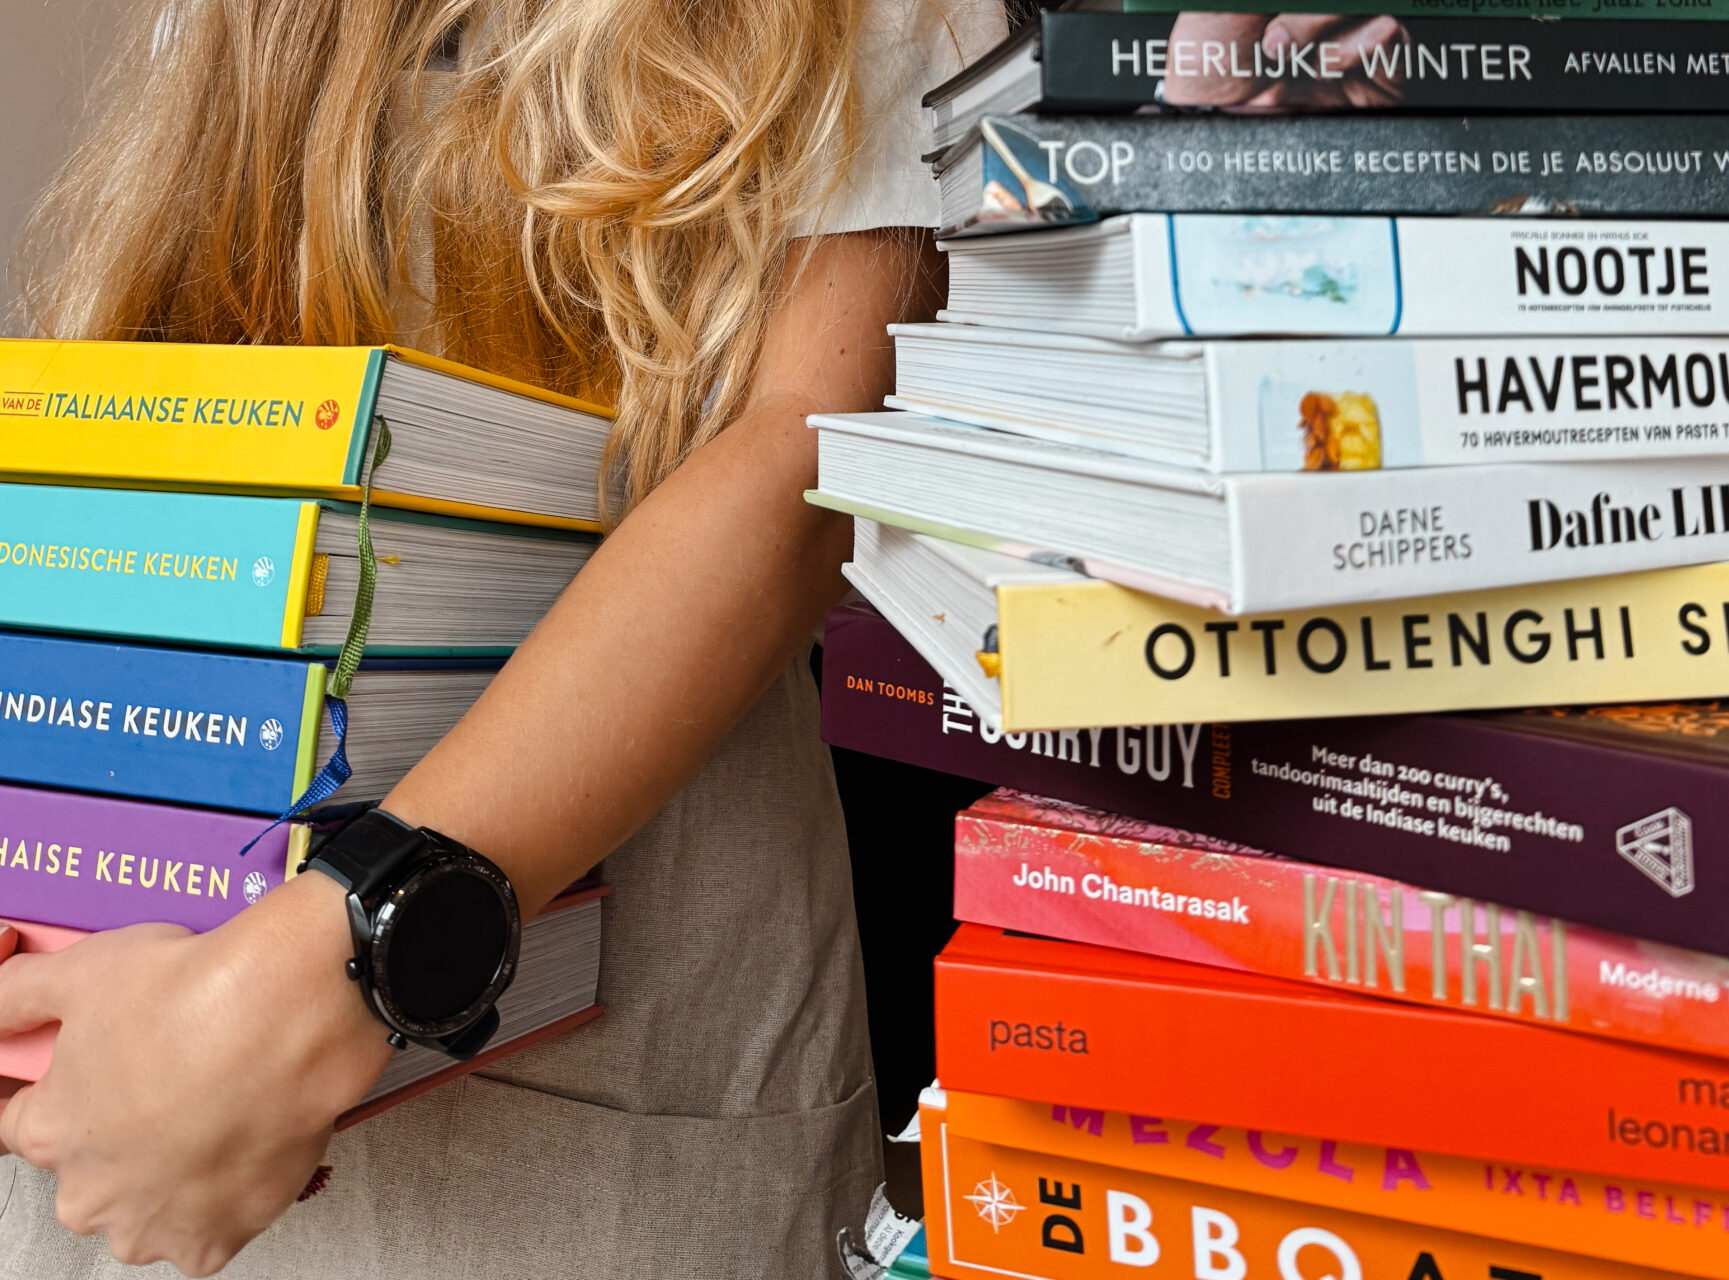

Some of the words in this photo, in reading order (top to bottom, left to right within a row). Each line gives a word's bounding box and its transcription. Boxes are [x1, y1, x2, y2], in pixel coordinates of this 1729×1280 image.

[1111, 38, 1344, 79] HEERLIJKE
[1358, 42, 1532, 81] WINTER
[1564, 51, 1676, 74] AFVALLEN
[1686, 53, 1729, 76] MET
[1038, 140, 1135, 185] TOP
[1167, 150, 1213, 172] 100
[1224, 150, 1342, 175] HEERLIJKE
[1354, 150, 1481, 173] RECEPTEN
[1492, 151, 1531, 173] DIE
[1540, 151, 1564, 176] JE
[1575, 151, 1702, 173] ABSOLUUT
[1515, 246, 1710, 296] NOOTJE
[2, 397, 24, 410] VAN
[26, 398, 42, 411] DE
[44, 393, 188, 422] ITALIAANSE
[193, 398, 304, 427] KEUKEN
[1460, 431, 1479, 448] 70
[1483, 426, 1639, 448] HAVERMOUTRECEPTEN
[1644, 425, 1671, 441] VAN
[1676, 424, 1719, 440] PASTA
[1359, 505, 1444, 538] DAFNE
[1526, 491, 1663, 552] Dafne
[143, 552, 238, 582] KEUKEN
[1332, 533, 1473, 570] SCHIPPERS
[1145, 606, 1634, 681] OTTOLENGHI
[1679, 602, 1729, 657] S
[847, 675, 873, 693] DAN
[878, 681, 934, 706] TOOMBS
[943, 679, 973, 735] TH
[123, 704, 247, 746] KEUKEN
[1312, 745, 1356, 771] Meer
[1360, 753, 1394, 778] dan
[1397, 765, 1432, 785] 200
[1250, 757, 1424, 808] tandoorimaaltijden
[1426, 792, 1451, 813] en
[1455, 790, 1584, 842] bijgerechten
[1312, 794, 1337, 816] uit
[1340, 796, 1364, 819] de
[1366, 804, 1434, 836] Indiase
[1438, 817, 1511, 853] keuken
[96, 850, 230, 900] KEUKEN
[1013, 863, 1075, 894] John
[1081, 873, 1249, 924] Chantarasak
[1303, 874, 1405, 992] KIN
[1418, 890, 1570, 1021] THAI
[1600, 961, 1719, 1003] Moderne
[989, 1020, 1089, 1055] pasta
[1485, 1166, 1582, 1206] IXTA
[1038, 1177, 1085, 1255] DE
